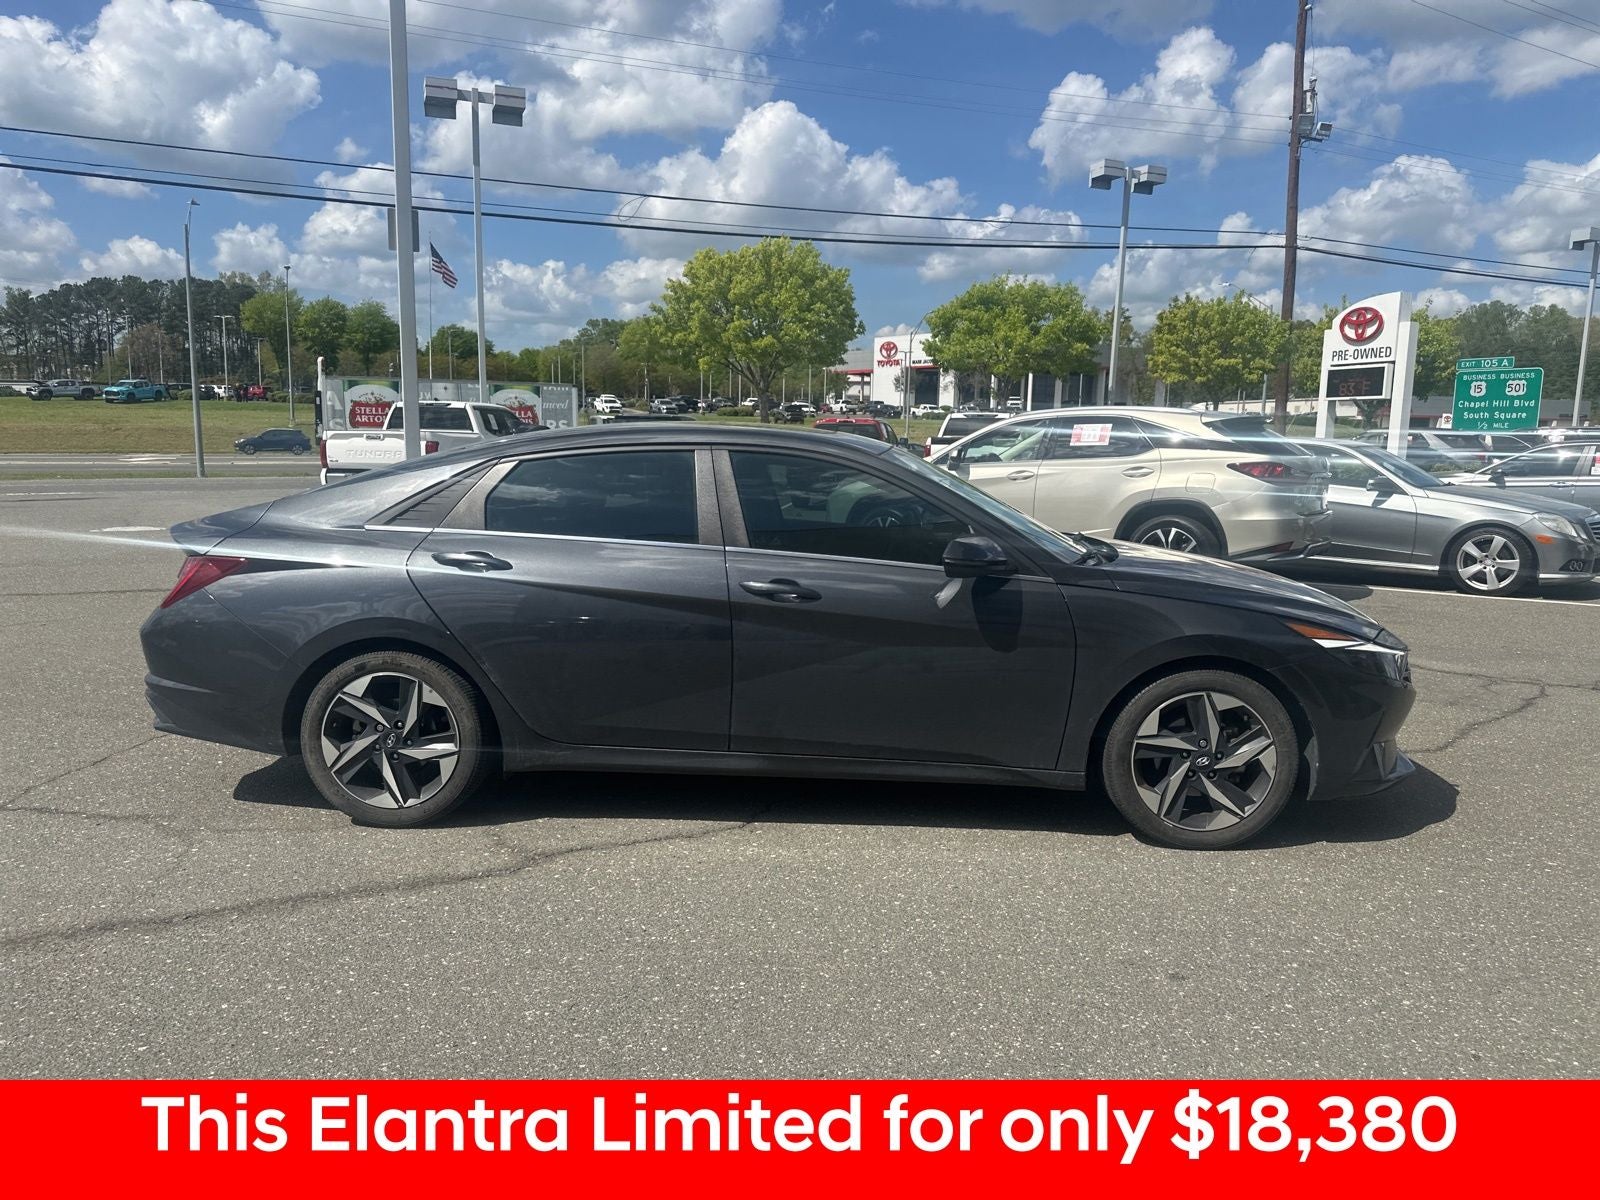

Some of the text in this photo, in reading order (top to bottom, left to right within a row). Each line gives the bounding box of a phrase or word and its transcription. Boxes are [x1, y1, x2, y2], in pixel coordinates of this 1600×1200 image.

[1331, 346, 1392, 361] PRE-OWNED
[1481, 359, 1498, 367] 105
[1501, 359, 1509, 367] A
[1463, 372, 1535, 381] BUSINESS BUSINESS
[1473, 383, 1525, 394] 15 501
[1458, 399, 1535, 408] Chapel Hill Blvd
[355, 406, 389, 415] STELLA
[1463, 411, 1527, 420] South Square
[345, 449, 403, 458] TUNDRA
